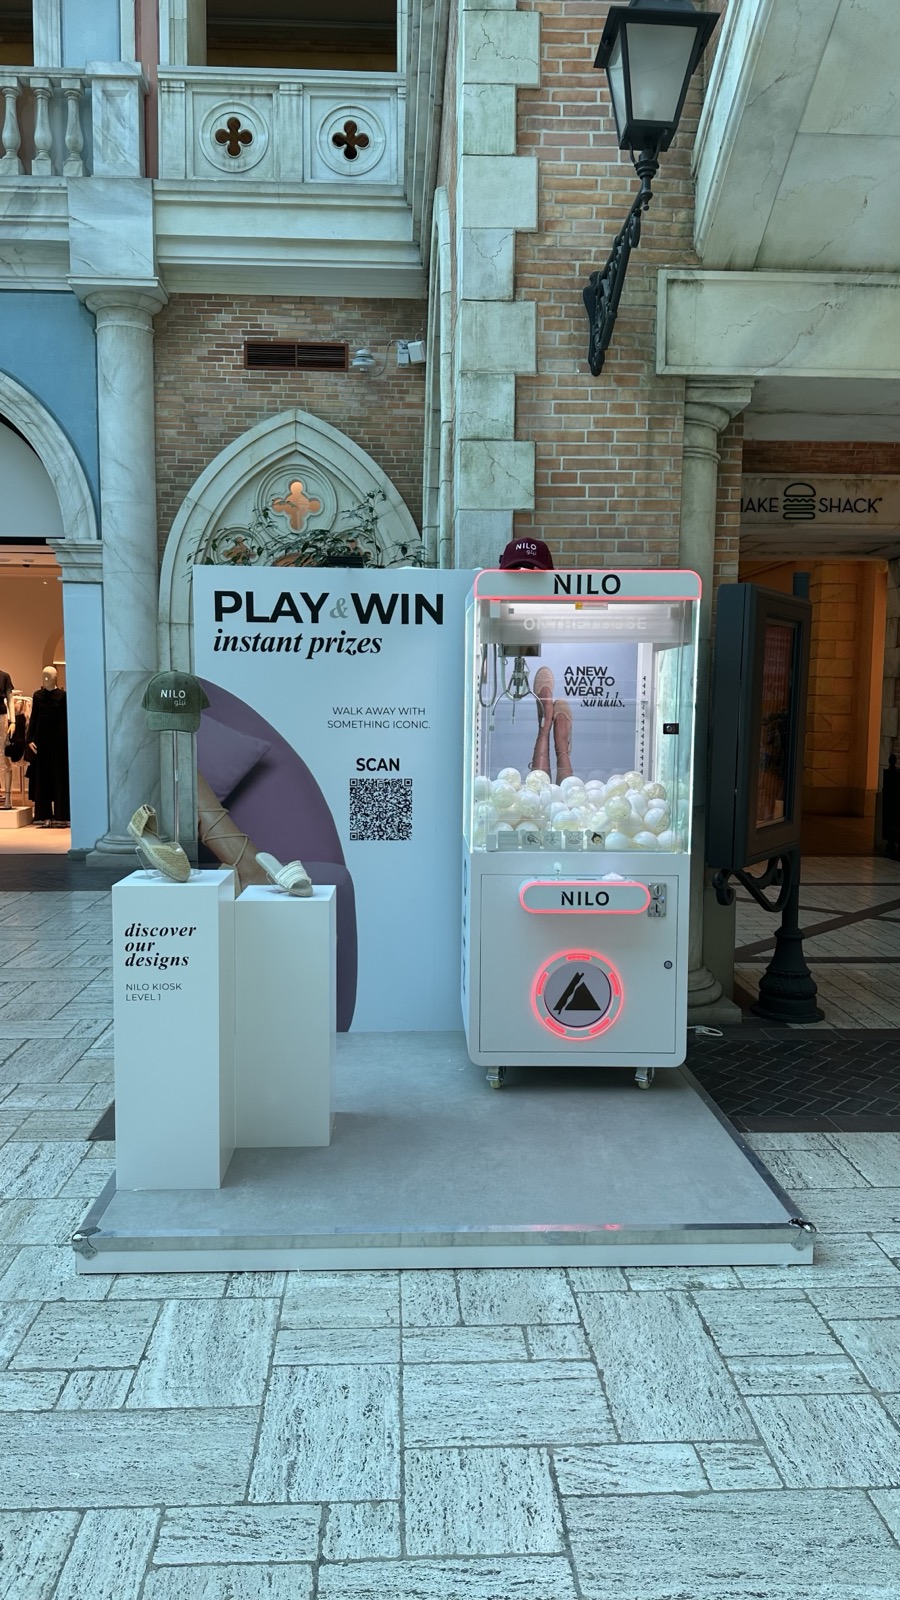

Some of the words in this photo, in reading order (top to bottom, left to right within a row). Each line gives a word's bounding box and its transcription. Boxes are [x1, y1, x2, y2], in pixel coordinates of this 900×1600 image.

[740, 497, 779, 513] AKE
[818, 497, 878, 513] SHACK
[515, 542, 537, 551] NILO
[553, 573, 621, 595] NILO
[214, 590, 330, 624] PLAY
[329, 597, 349, 619] &
[350, 592, 444, 625] WIN
[213, 628, 304, 653] instant
[305, 630, 383, 660] prizes
[563, 665, 575, 677] A
[576, 665, 608, 677] NEW
[564, 676, 597, 687] WAY
[597, 676, 616, 687] TO
[160, 689, 185, 698] NILO
[564, 686, 604, 697] WEAR
[332, 706, 363, 716] WALK
[365, 706, 396, 716] AWAY
[398, 706, 426, 716] WITH
[327, 719, 390, 730] SOMETHING
[392, 719, 431, 730] ICONIC.
[355, 757, 400, 772] SCAN
[560, 891, 610, 906] NILO
[124, 922, 197, 937] discover
[124, 941, 155, 952] our
[124, 952, 190, 970] designs
[125, 983, 150, 991] NILO
[152, 982, 182, 991] KIOSK
[125, 993, 156, 1002] LEVEL
[157, 993, 161, 1001] 1
